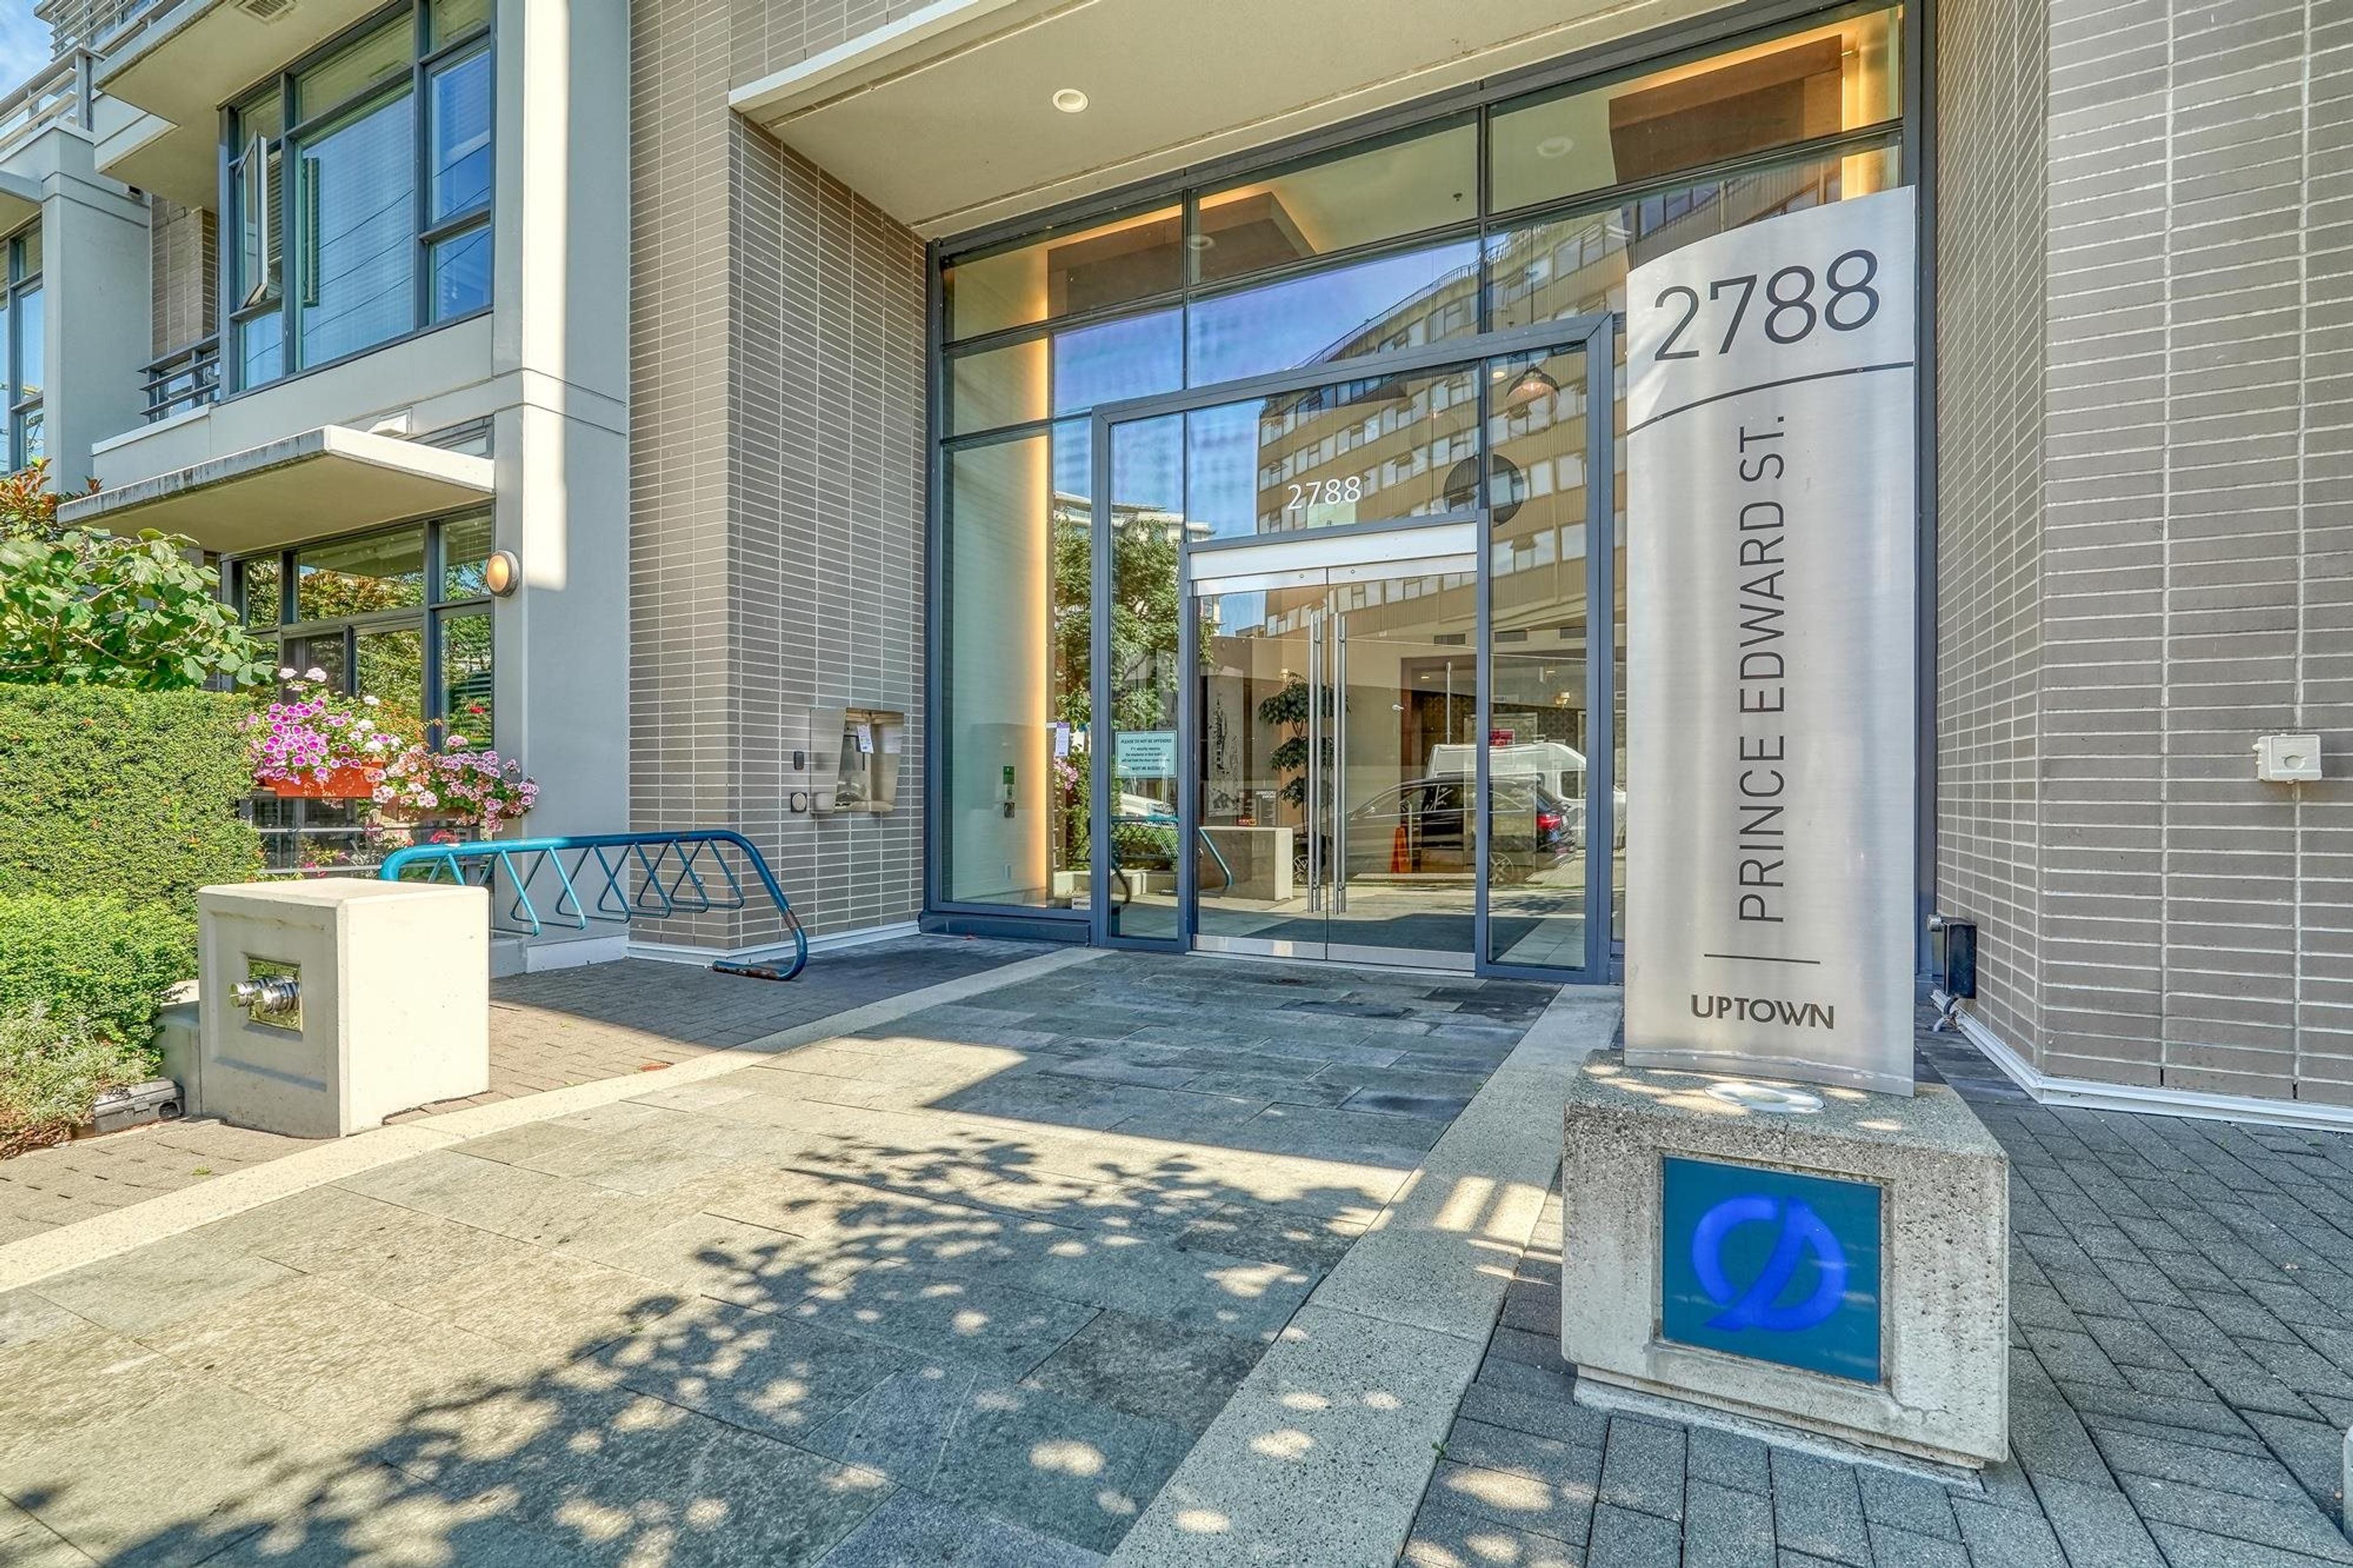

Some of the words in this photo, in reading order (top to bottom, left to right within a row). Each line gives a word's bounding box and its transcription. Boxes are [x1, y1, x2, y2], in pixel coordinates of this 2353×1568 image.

[1654, 249, 1880, 362] 2788
[1287, 475, 1362, 510] 2788
[1739, 416, 1784, 482] ST.
[1739, 501, 1784, 713] EDWARD
[1739, 735, 1784, 923] PRINCE
[1691, 994, 1834, 1029] UPTOWN
